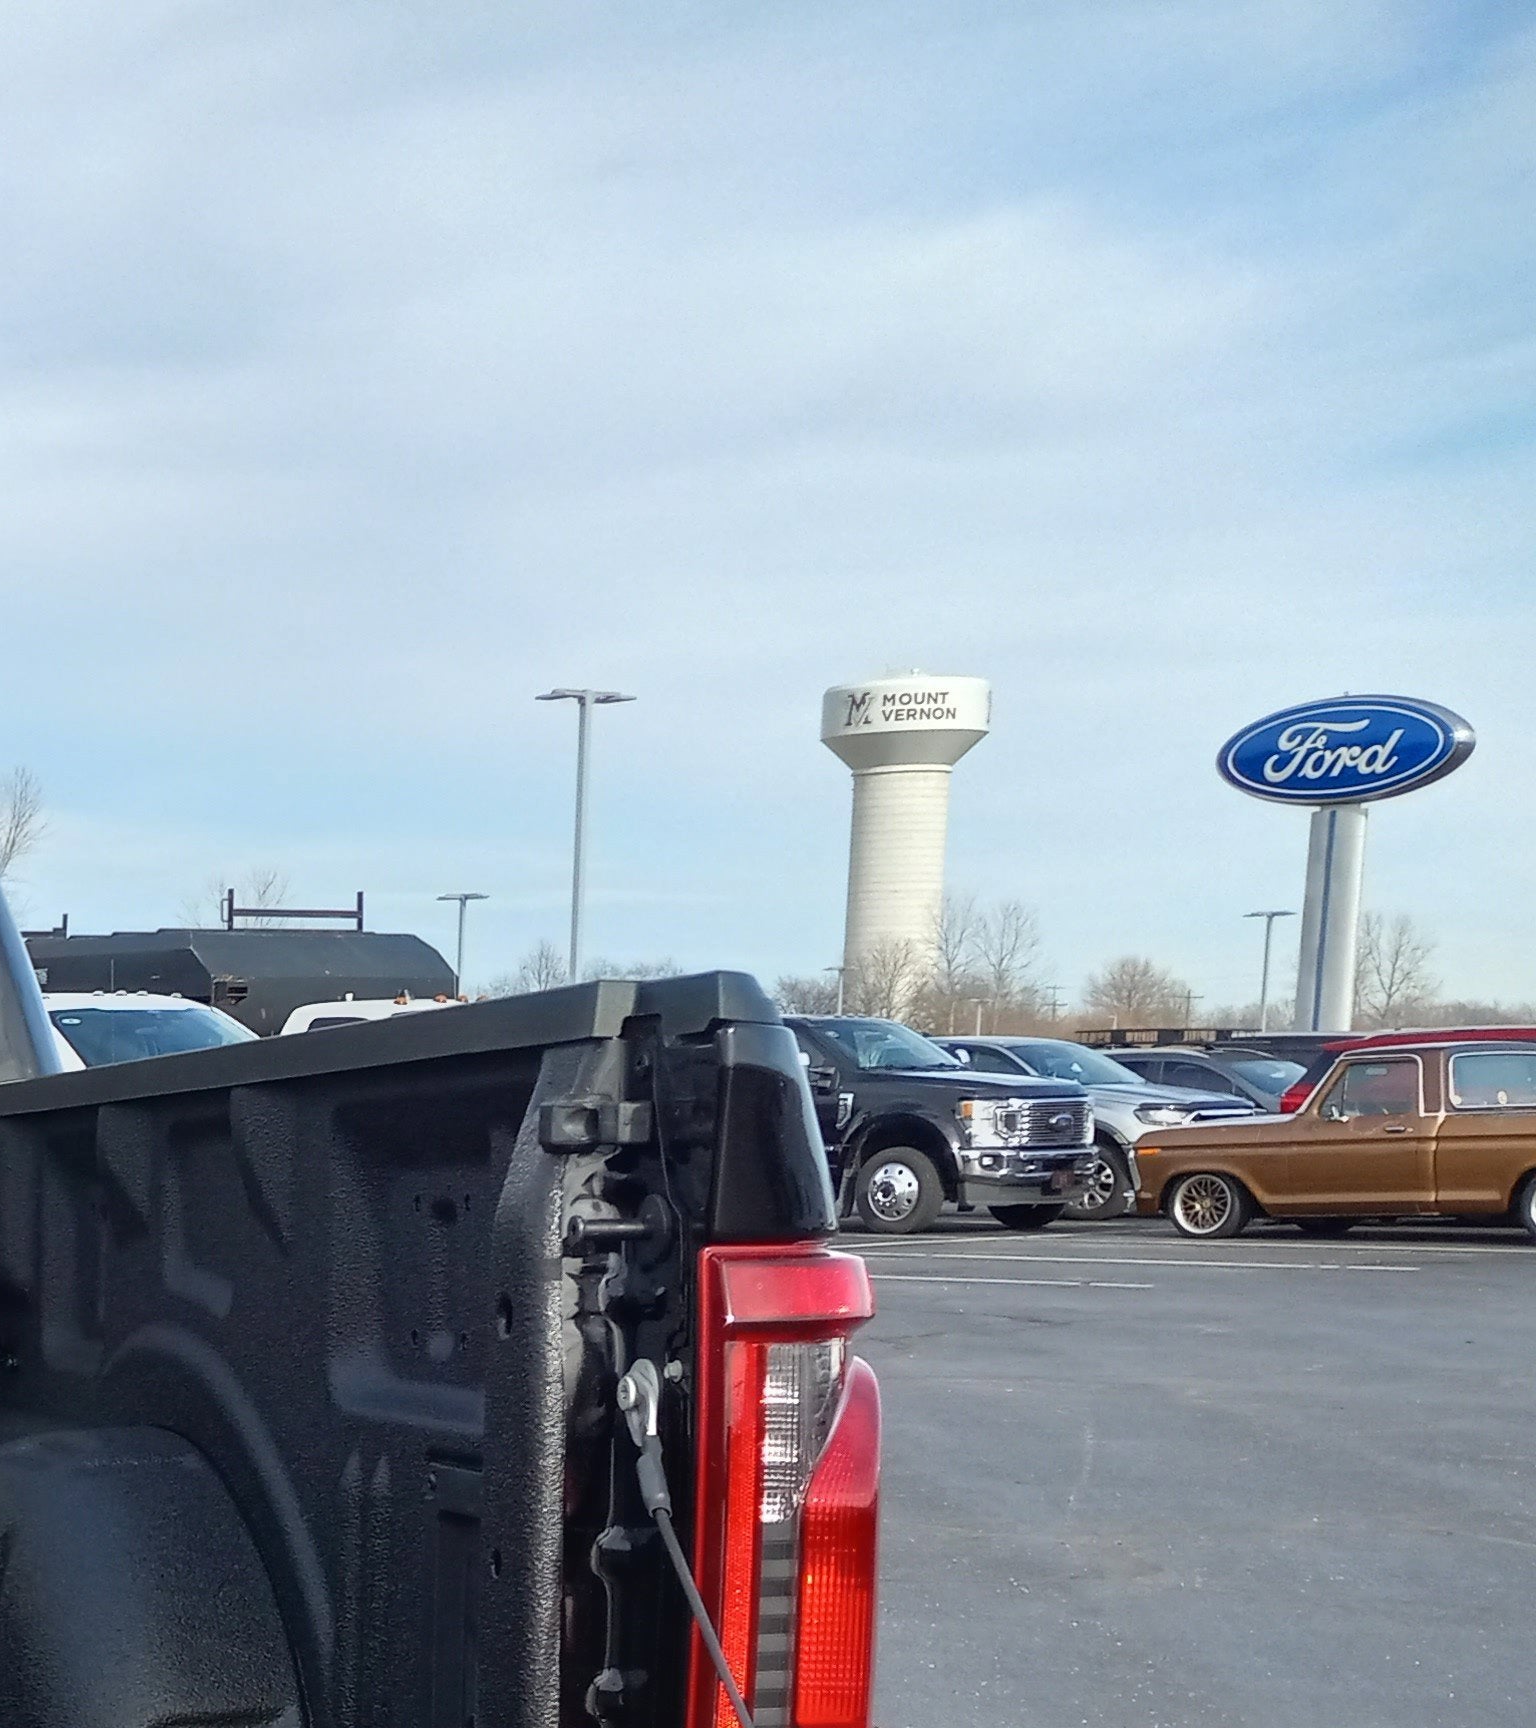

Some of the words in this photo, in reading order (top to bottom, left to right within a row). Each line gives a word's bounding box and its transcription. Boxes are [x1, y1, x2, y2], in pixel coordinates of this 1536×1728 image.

[882, 691, 950, 707] MOUNT
[881, 707, 957, 722] VERNON
[1263, 716, 1406, 783] Ford
